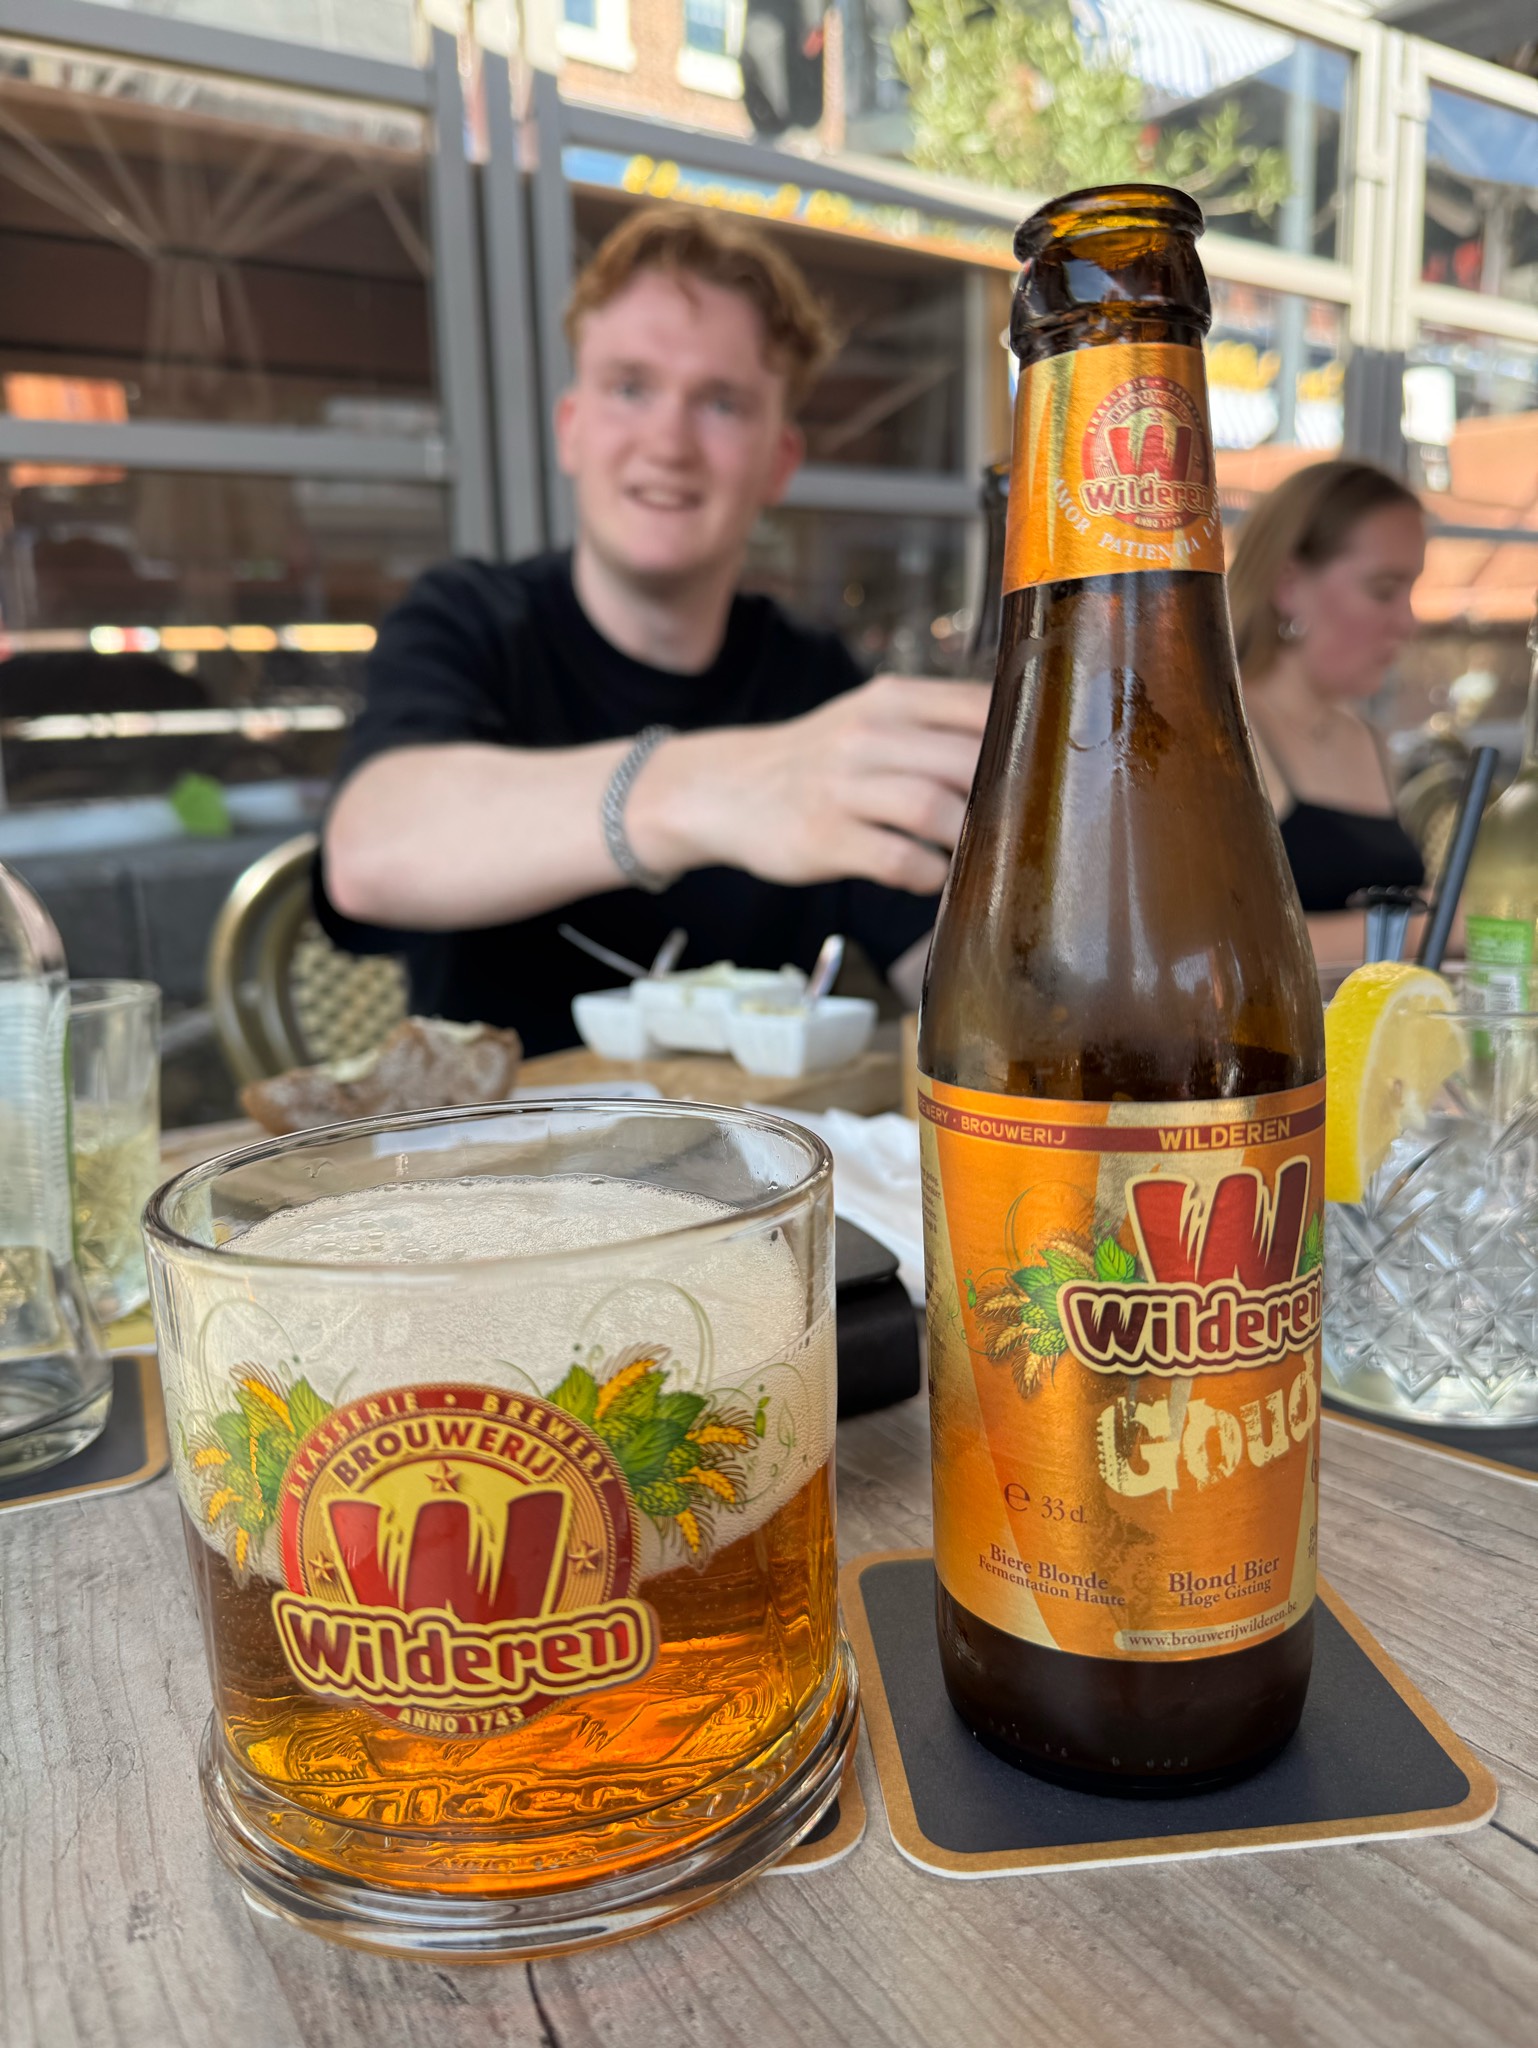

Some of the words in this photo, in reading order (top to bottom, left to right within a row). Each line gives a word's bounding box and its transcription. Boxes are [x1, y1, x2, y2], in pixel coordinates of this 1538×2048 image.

[1053, 478, 1091, 534] AMOR
[961, 1115, 1067, 1145] BROUWERIJ
[1158, 1117, 1291, 1151] WILDEREN
[288, 1391, 420, 1498] BRASSERIE
[481, 1391, 615, 1485] BREWERY
[331, 1420, 558, 1486] BROUWERIJ
[1041, 1496, 1065, 1521] 33
[979, 1554, 1070, 1599] Fermentation
[1076, 1588, 1126, 1607] Haute
[990, 1543, 1032, 1574] Biere
[1038, 1561, 1109, 1590] Blonde
[1168, 1564, 1237, 1593] Blond
[1244, 1557, 1280, 1582] Bier
[1179, 1593, 1220, 1609] Hoge
[1225, 1578, 1271, 1601] Gisting
[1129, 1600, 1298, 1646] www.brouwerijwilderen.be
[284, 1606, 640, 1692] Wilderen
[397, 1707, 458, 1734] ANNO
[466, 1706, 525, 1734] 1743
